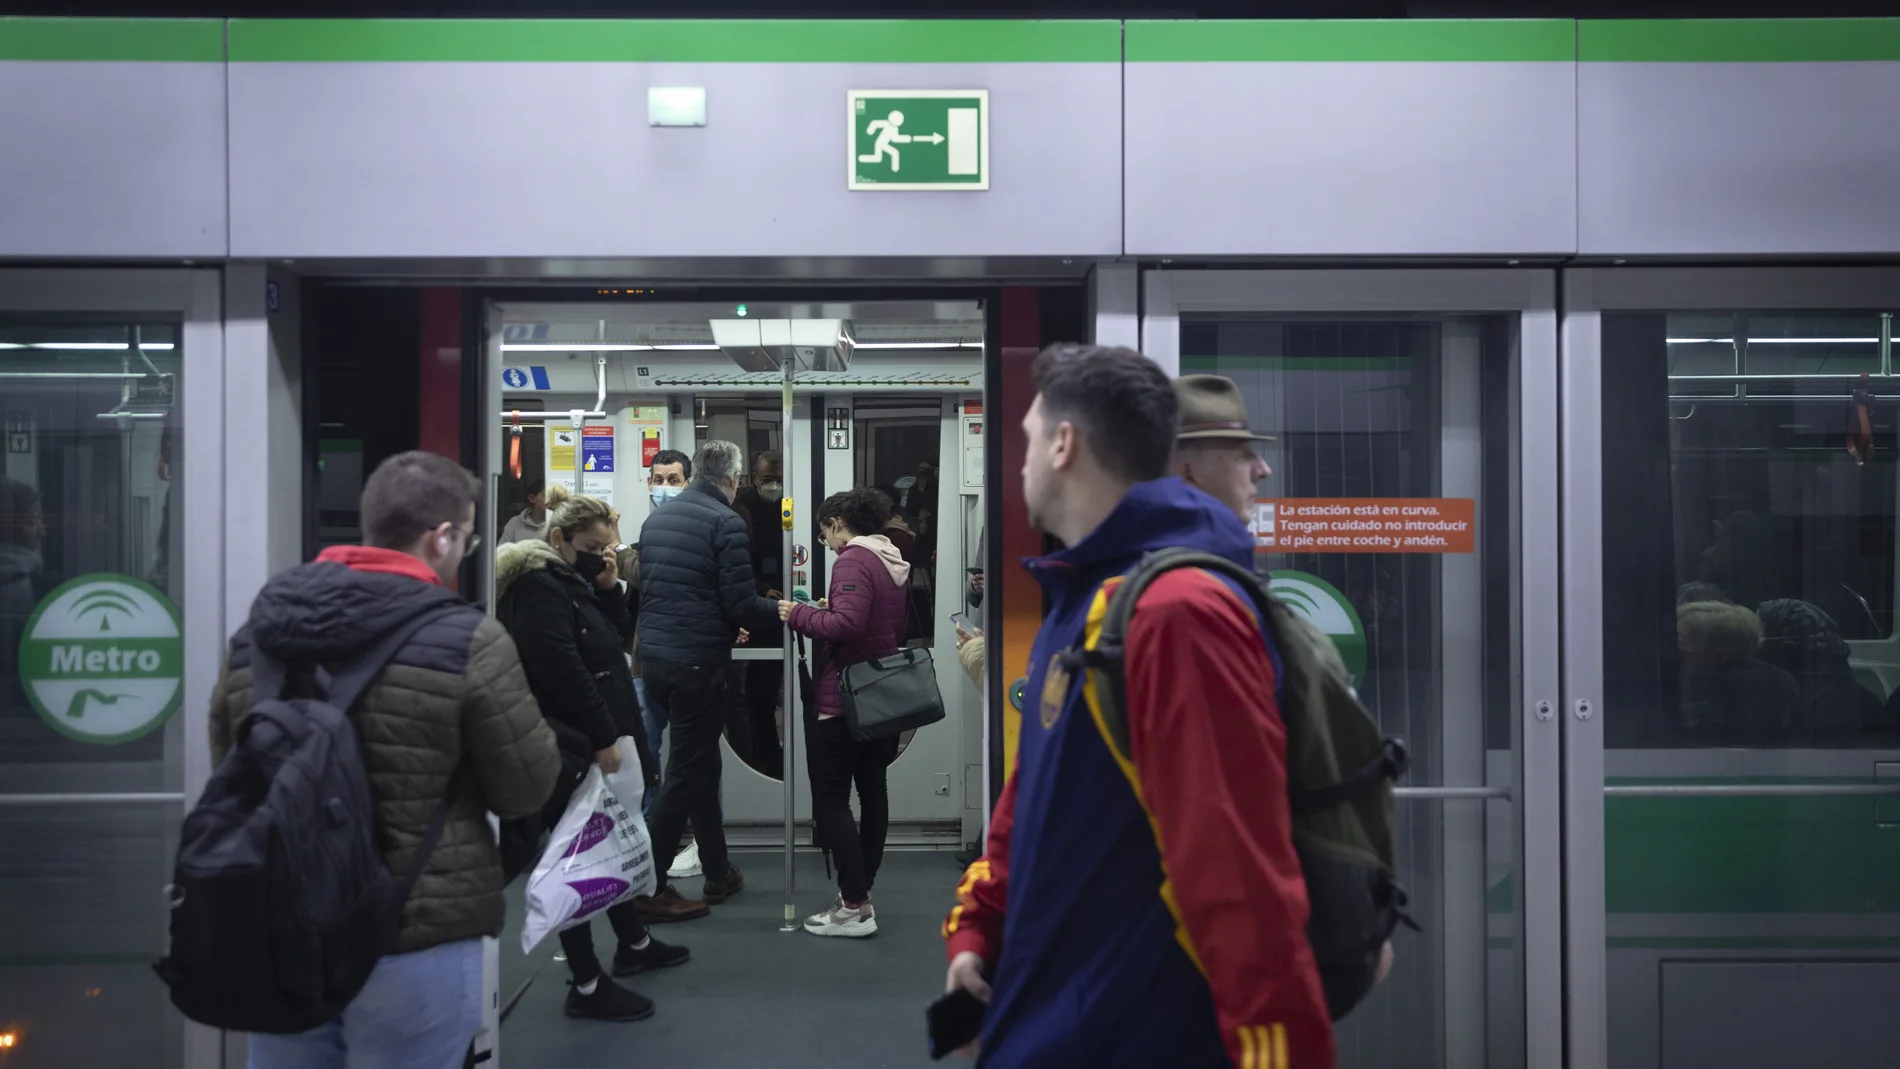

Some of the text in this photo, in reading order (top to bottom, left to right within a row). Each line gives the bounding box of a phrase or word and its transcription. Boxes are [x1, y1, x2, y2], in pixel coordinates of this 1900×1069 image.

[1280, 504, 1440, 516] La estación está en curva.
[1280, 520, 1468, 532] Tengan cuidado no introducir
[1280, 535, 1448, 548] el pie entre coche y andén.
[50, 644, 161, 673] Metro
